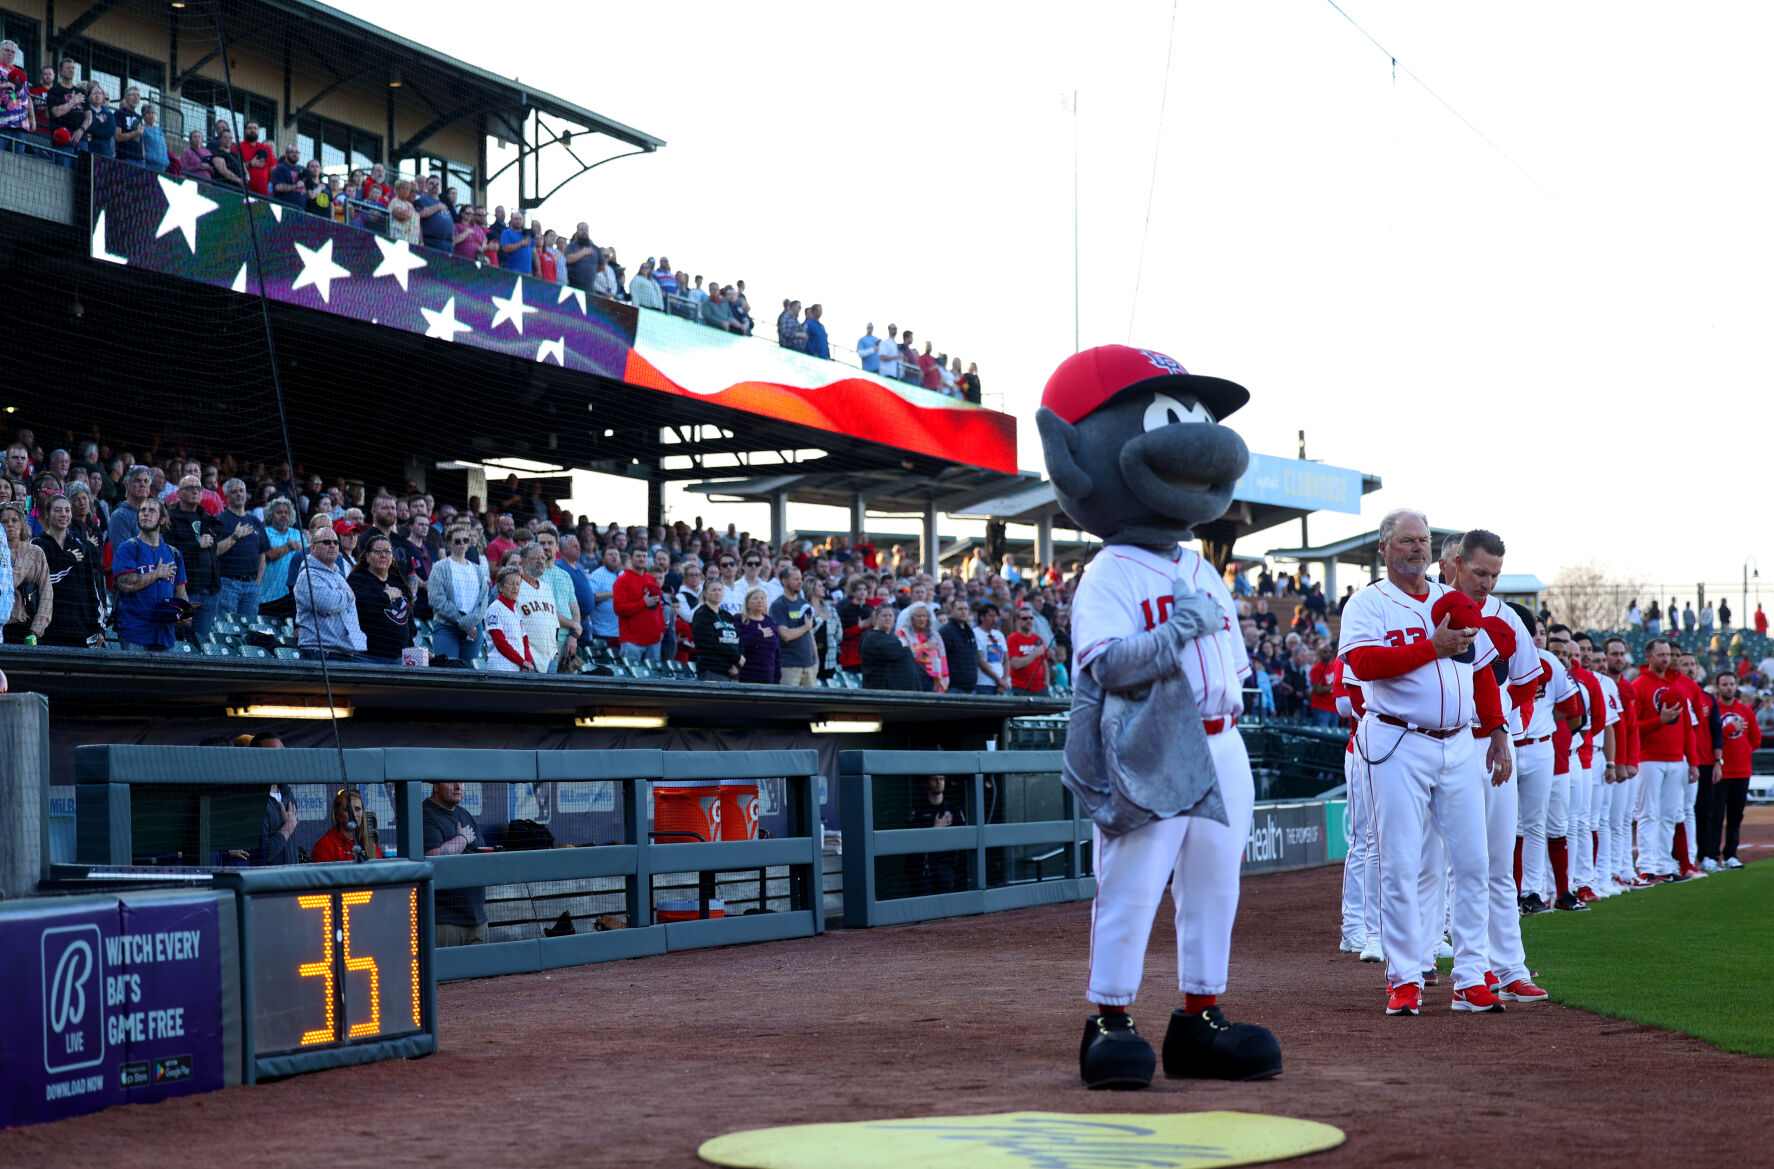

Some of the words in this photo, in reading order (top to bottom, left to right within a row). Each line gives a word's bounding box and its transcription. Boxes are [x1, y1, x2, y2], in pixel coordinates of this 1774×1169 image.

[105, 933, 153, 966] WATCH
[155, 930, 200, 962] EVERY
[66, 1031, 84, 1053] LIVE
[108, 1012, 145, 1045] GAME
[148, 1008, 184, 1040] FREE
[46, 1079, 86, 1101] DOWNLOAD
[87, 1075, 104, 1092] NOW
